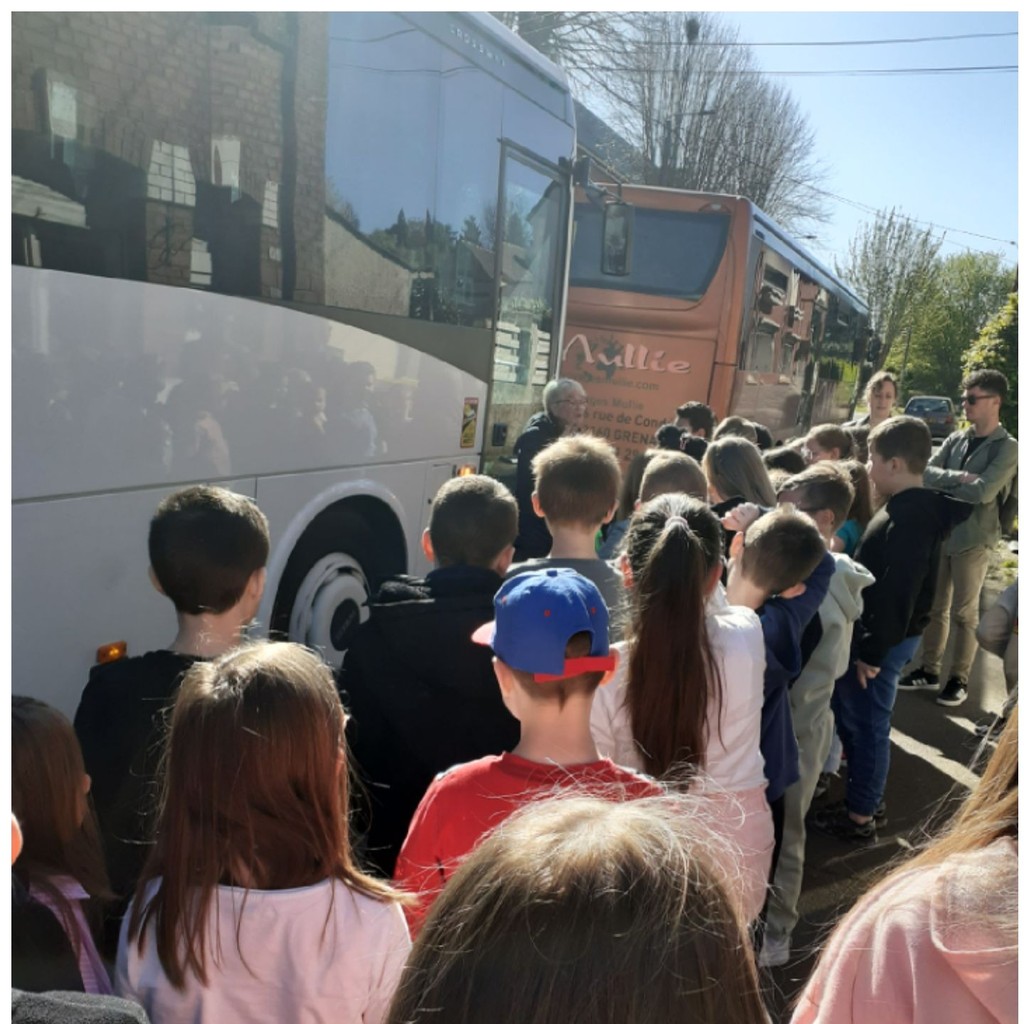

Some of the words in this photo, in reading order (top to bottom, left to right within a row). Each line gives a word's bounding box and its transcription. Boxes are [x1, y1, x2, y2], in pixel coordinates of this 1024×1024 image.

[593, 411, 613, 422] rue
[616, 411, 632, 425] de
[634, 414, 675, 428] Cond
[613, 428, 657, 446] GRENA
